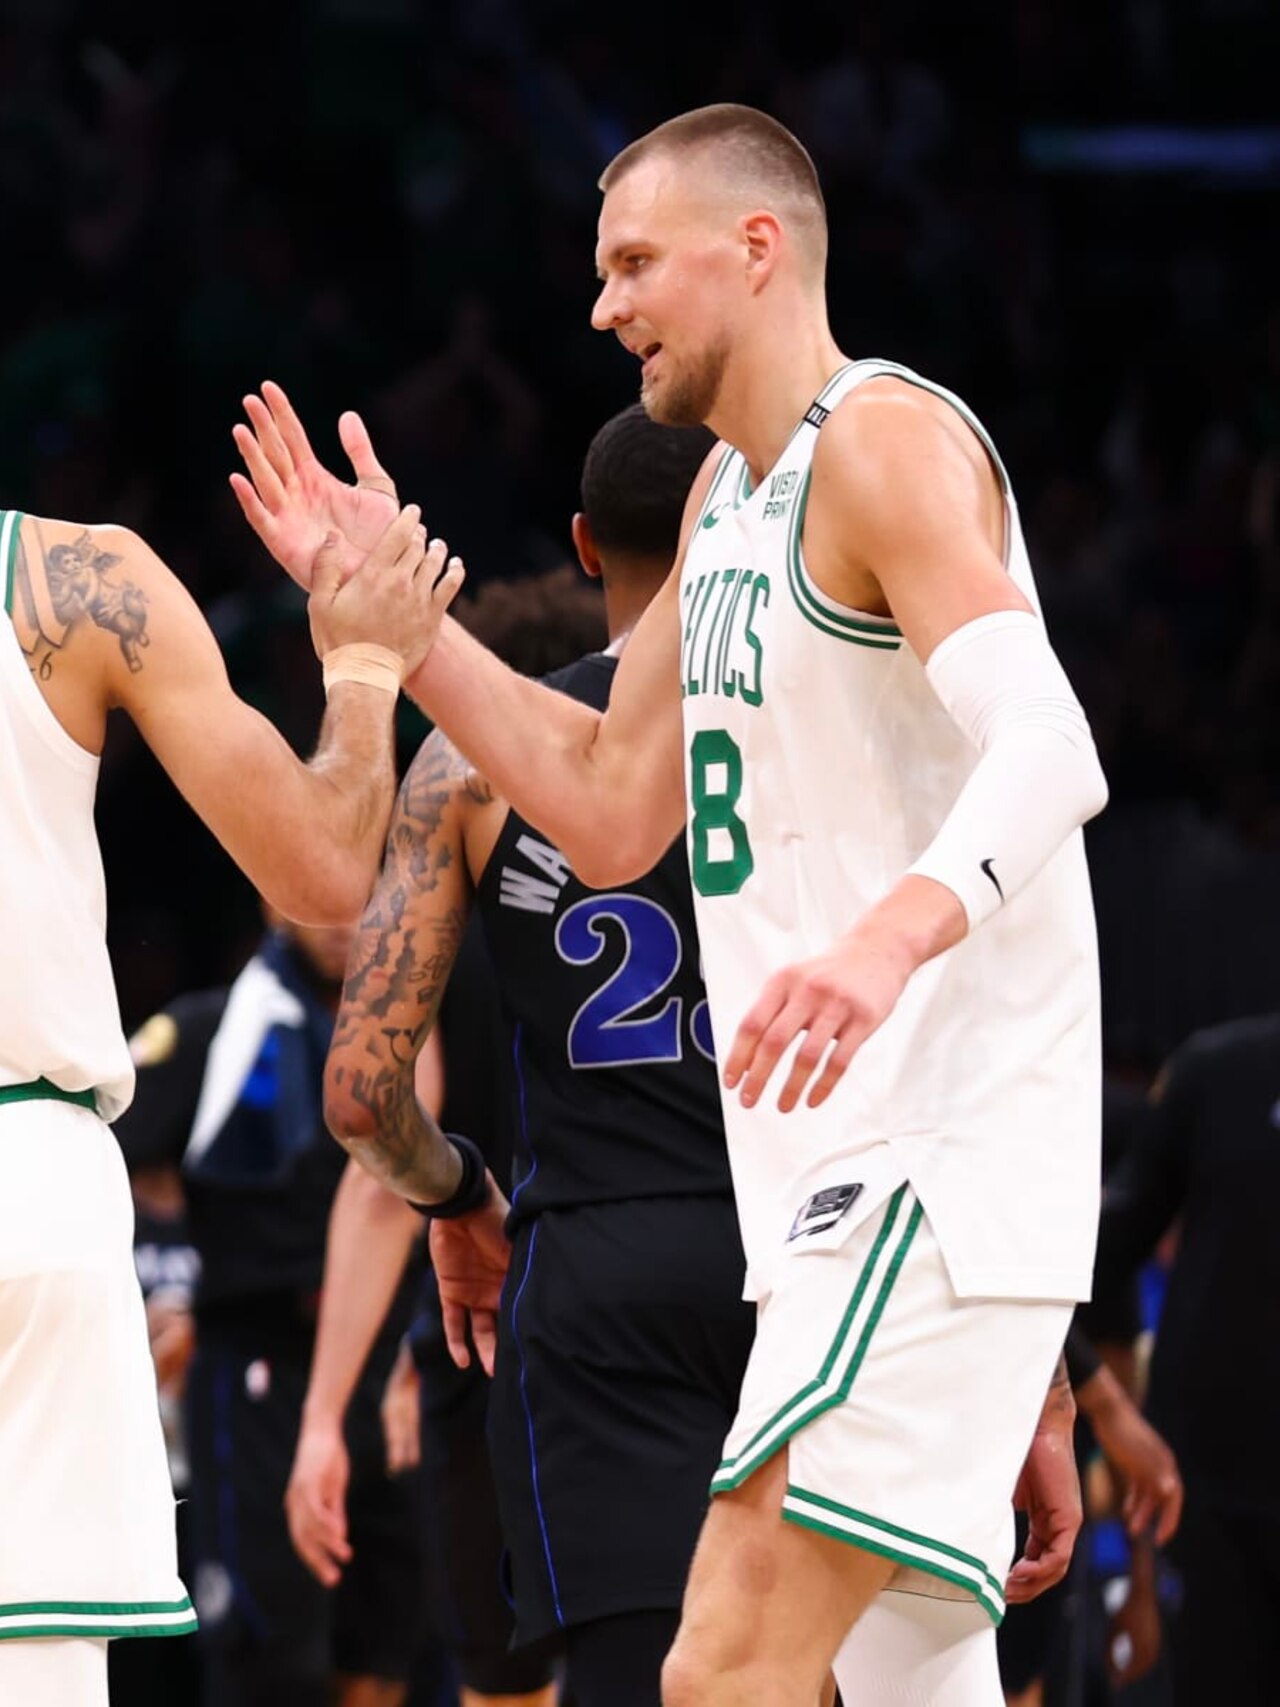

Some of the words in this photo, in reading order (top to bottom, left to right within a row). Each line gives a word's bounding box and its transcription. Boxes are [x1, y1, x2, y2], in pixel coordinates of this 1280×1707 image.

[681, 568, 770, 708] ELTICS
[690, 729, 754, 896] 8
[554, 893, 717, 1069] 2
